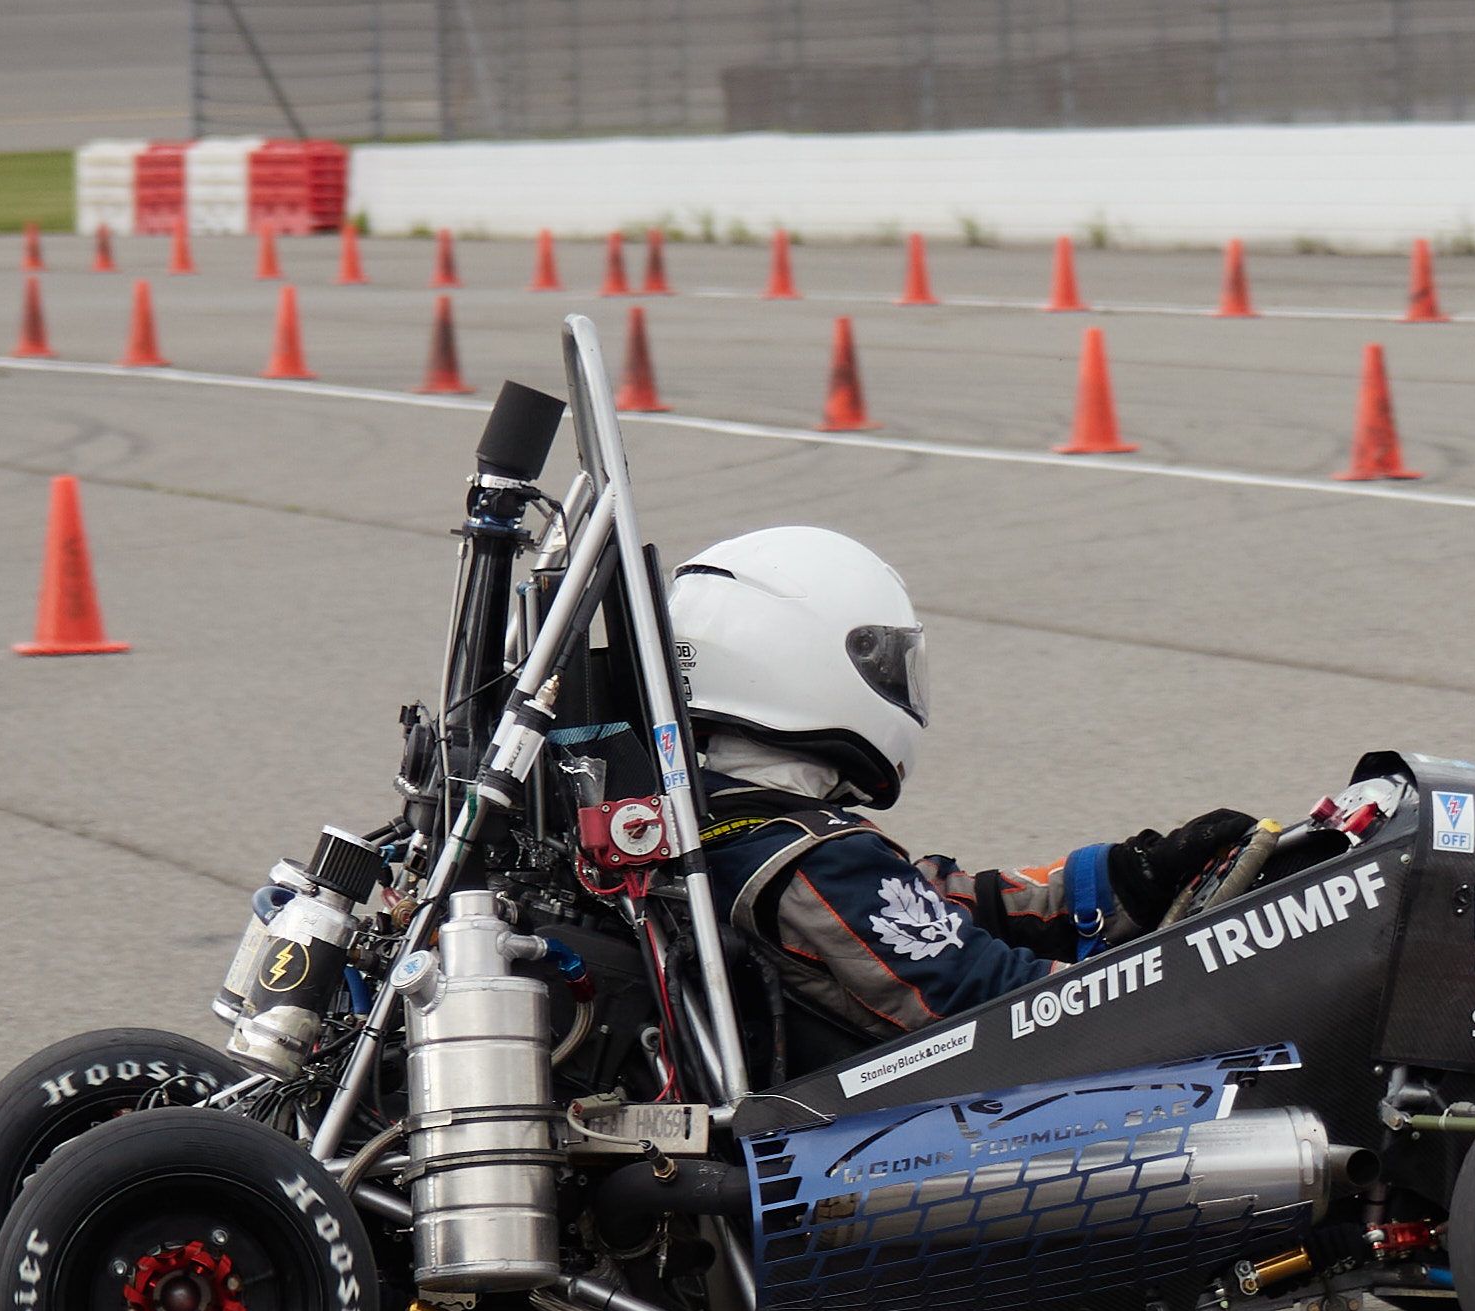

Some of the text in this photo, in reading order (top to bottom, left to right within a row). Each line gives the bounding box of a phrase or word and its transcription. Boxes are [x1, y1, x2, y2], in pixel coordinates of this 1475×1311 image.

[663, 772, 686, 788] OFF
[1441, 834, 1467, 847] OFF
[1185, 861, 1386, 973] TRUMPF
[1011, 946, 1163, 1040] LOCTITE
[843, 1099, 1191, 1185] UCONN FORMULA SAE
